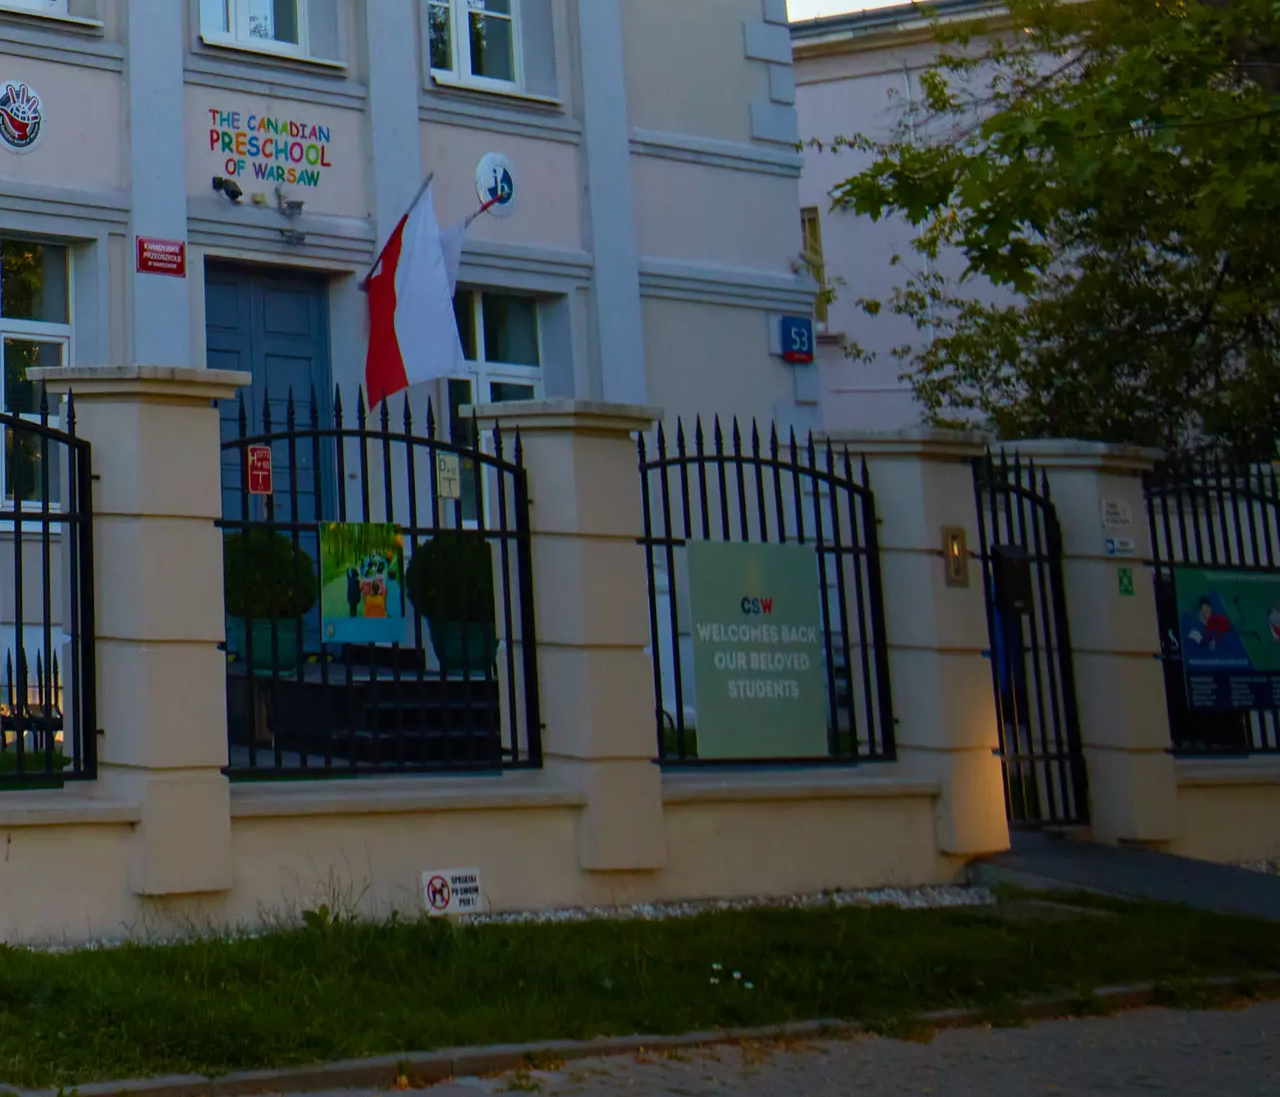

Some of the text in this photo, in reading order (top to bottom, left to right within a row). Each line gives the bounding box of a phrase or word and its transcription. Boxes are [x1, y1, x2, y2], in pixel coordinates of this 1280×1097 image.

[209, 108, 330, 143] THE CANADIAN
[209, 128, 332, 167] PRESCHOOL
[225, 158, 320, 187] OF WARSAW
[791, 327, 808, 352] 53
[740, 597, 773, 615] CSW
[696, 622, 818, 643] WELCOMES BACK
[714, 651, 810, 671] OUR BELOVED
[728, 679, 800, 699] STUDENTS
